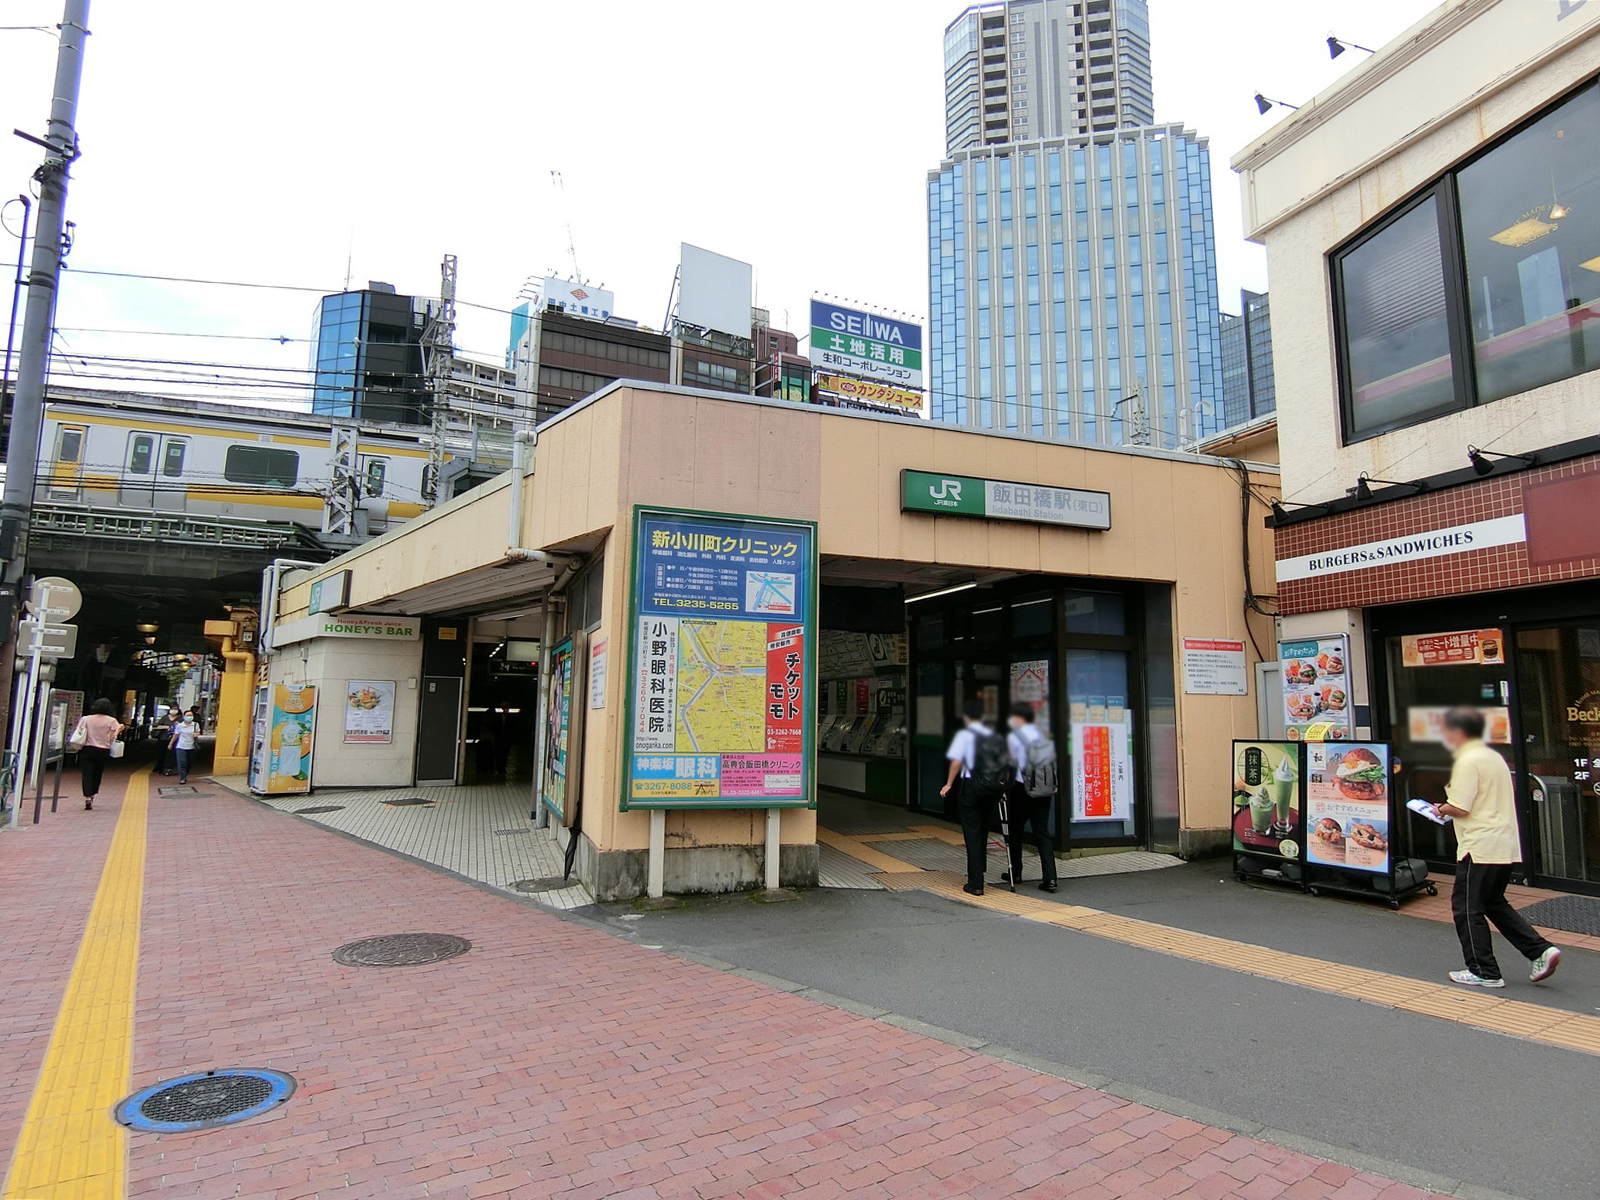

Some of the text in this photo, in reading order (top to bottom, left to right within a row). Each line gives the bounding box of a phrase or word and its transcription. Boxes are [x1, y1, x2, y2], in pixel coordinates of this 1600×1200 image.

[829, 311, 904, 345] SEIWA
[829, 334, 905, 365] 土地活用
[822, 352, 912, 379] 生和コーポレーション
[857, 385, 922, 408] カンダジュース
[929, 479, 962, 501] JR
[992, 504, 1064, 521] Iidabashi Station
[652, 530, 798, 558] 新小川町クリニック
[1308, 530, 1475, 572] BURGERS&SANDWICHES
[324, 624, 413, 636] HONEY'S BAR
[1433, 633, 1478, 649] ミート増量中
[648, 621, 668, 733] 小野眼科医院
[785, 651, 801, 720] チケット
[769, 682, 784, 720] モモ
[675, 757, 717, 778] 眼科
[1248, 754, 1258, 779] 抹茶
[1574, 758, 1588, 768] 1F
[1574, 771, 1590, 780] 2F
